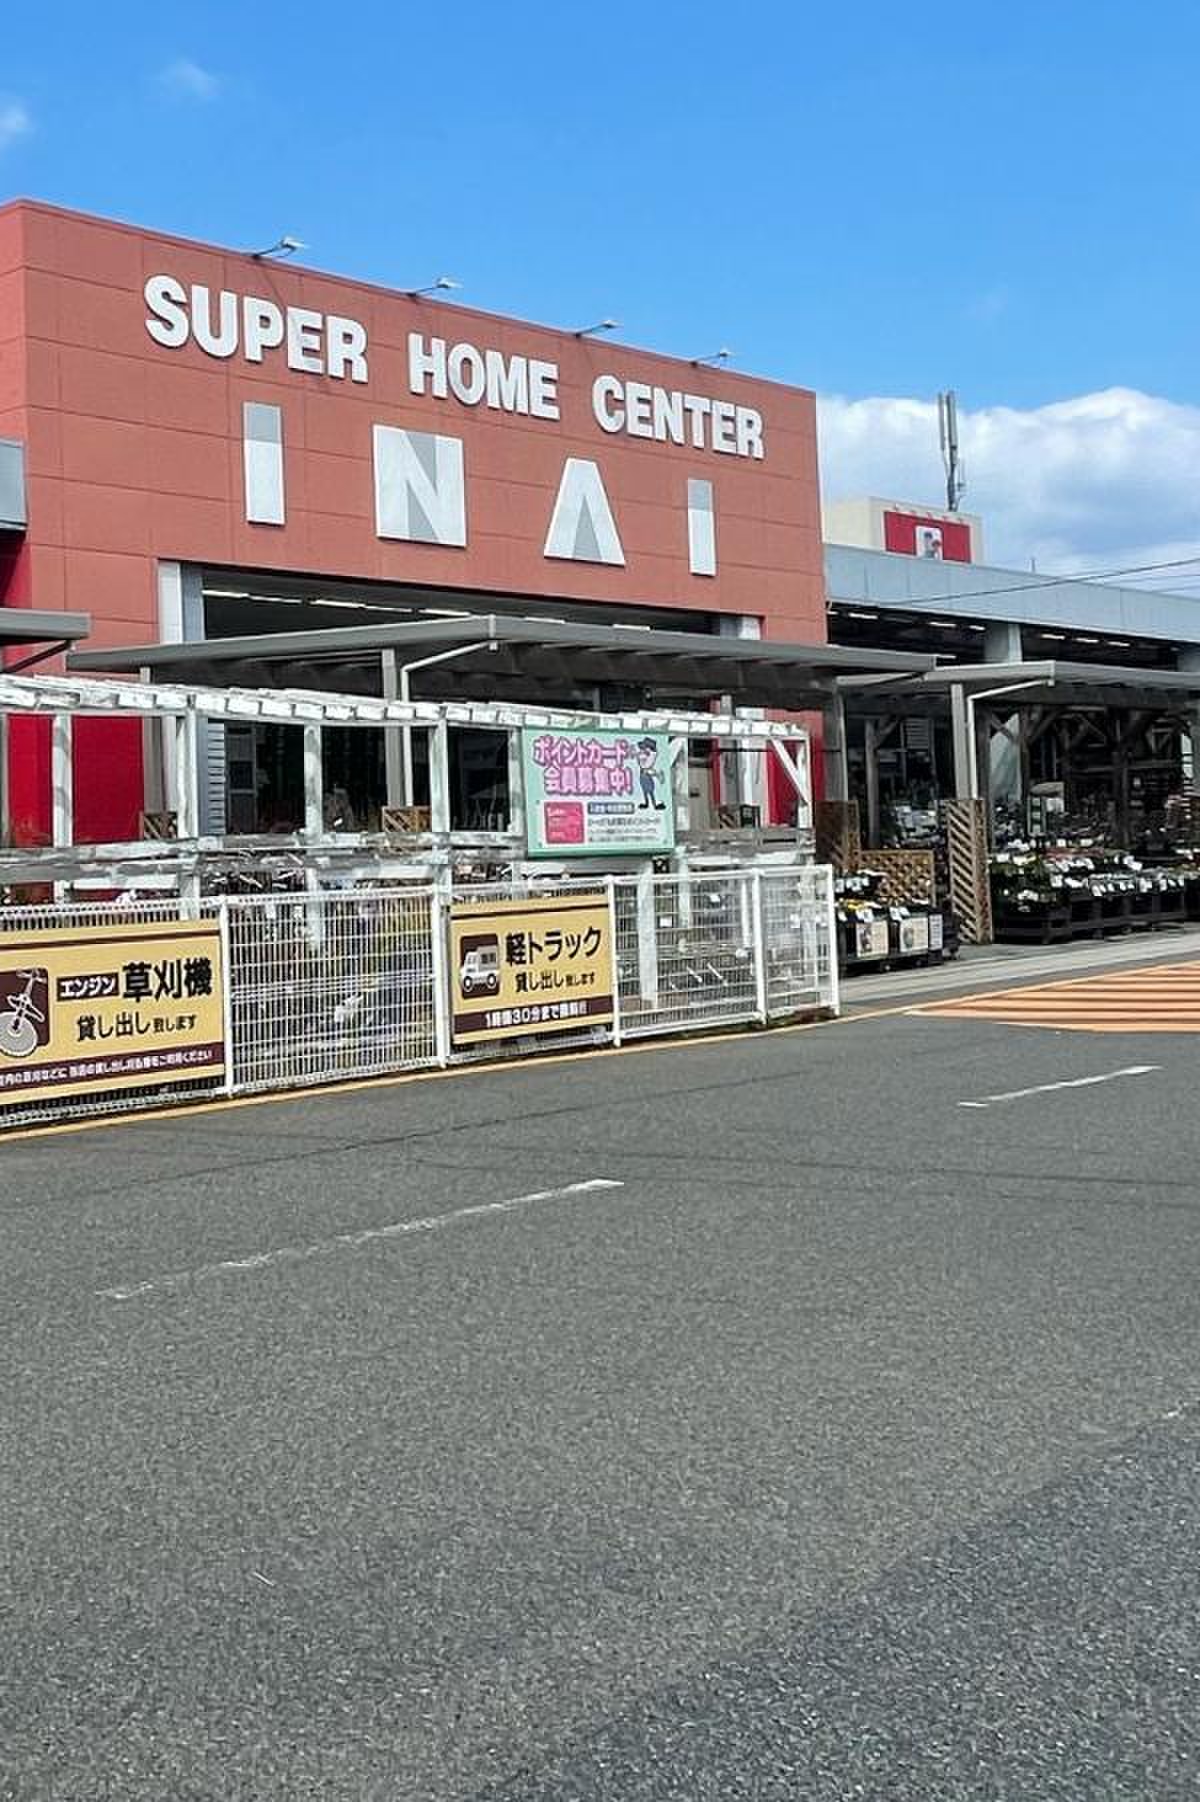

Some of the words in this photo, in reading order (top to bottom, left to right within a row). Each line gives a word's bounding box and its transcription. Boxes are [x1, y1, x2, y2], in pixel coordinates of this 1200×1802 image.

[144, 274, 368, 383] SUPER
[409, 333, 560, 420] HOME
[592, 375, 765, 459] CENTER
[242, 402, 717, 577] INAI
[533, 735, 629, 767] ポイントカード
[505, 926, 602, 966] 軽トラック
[60, 976, 117, 998] エンジン
[121, 957, 212, 1003] 草刈機
